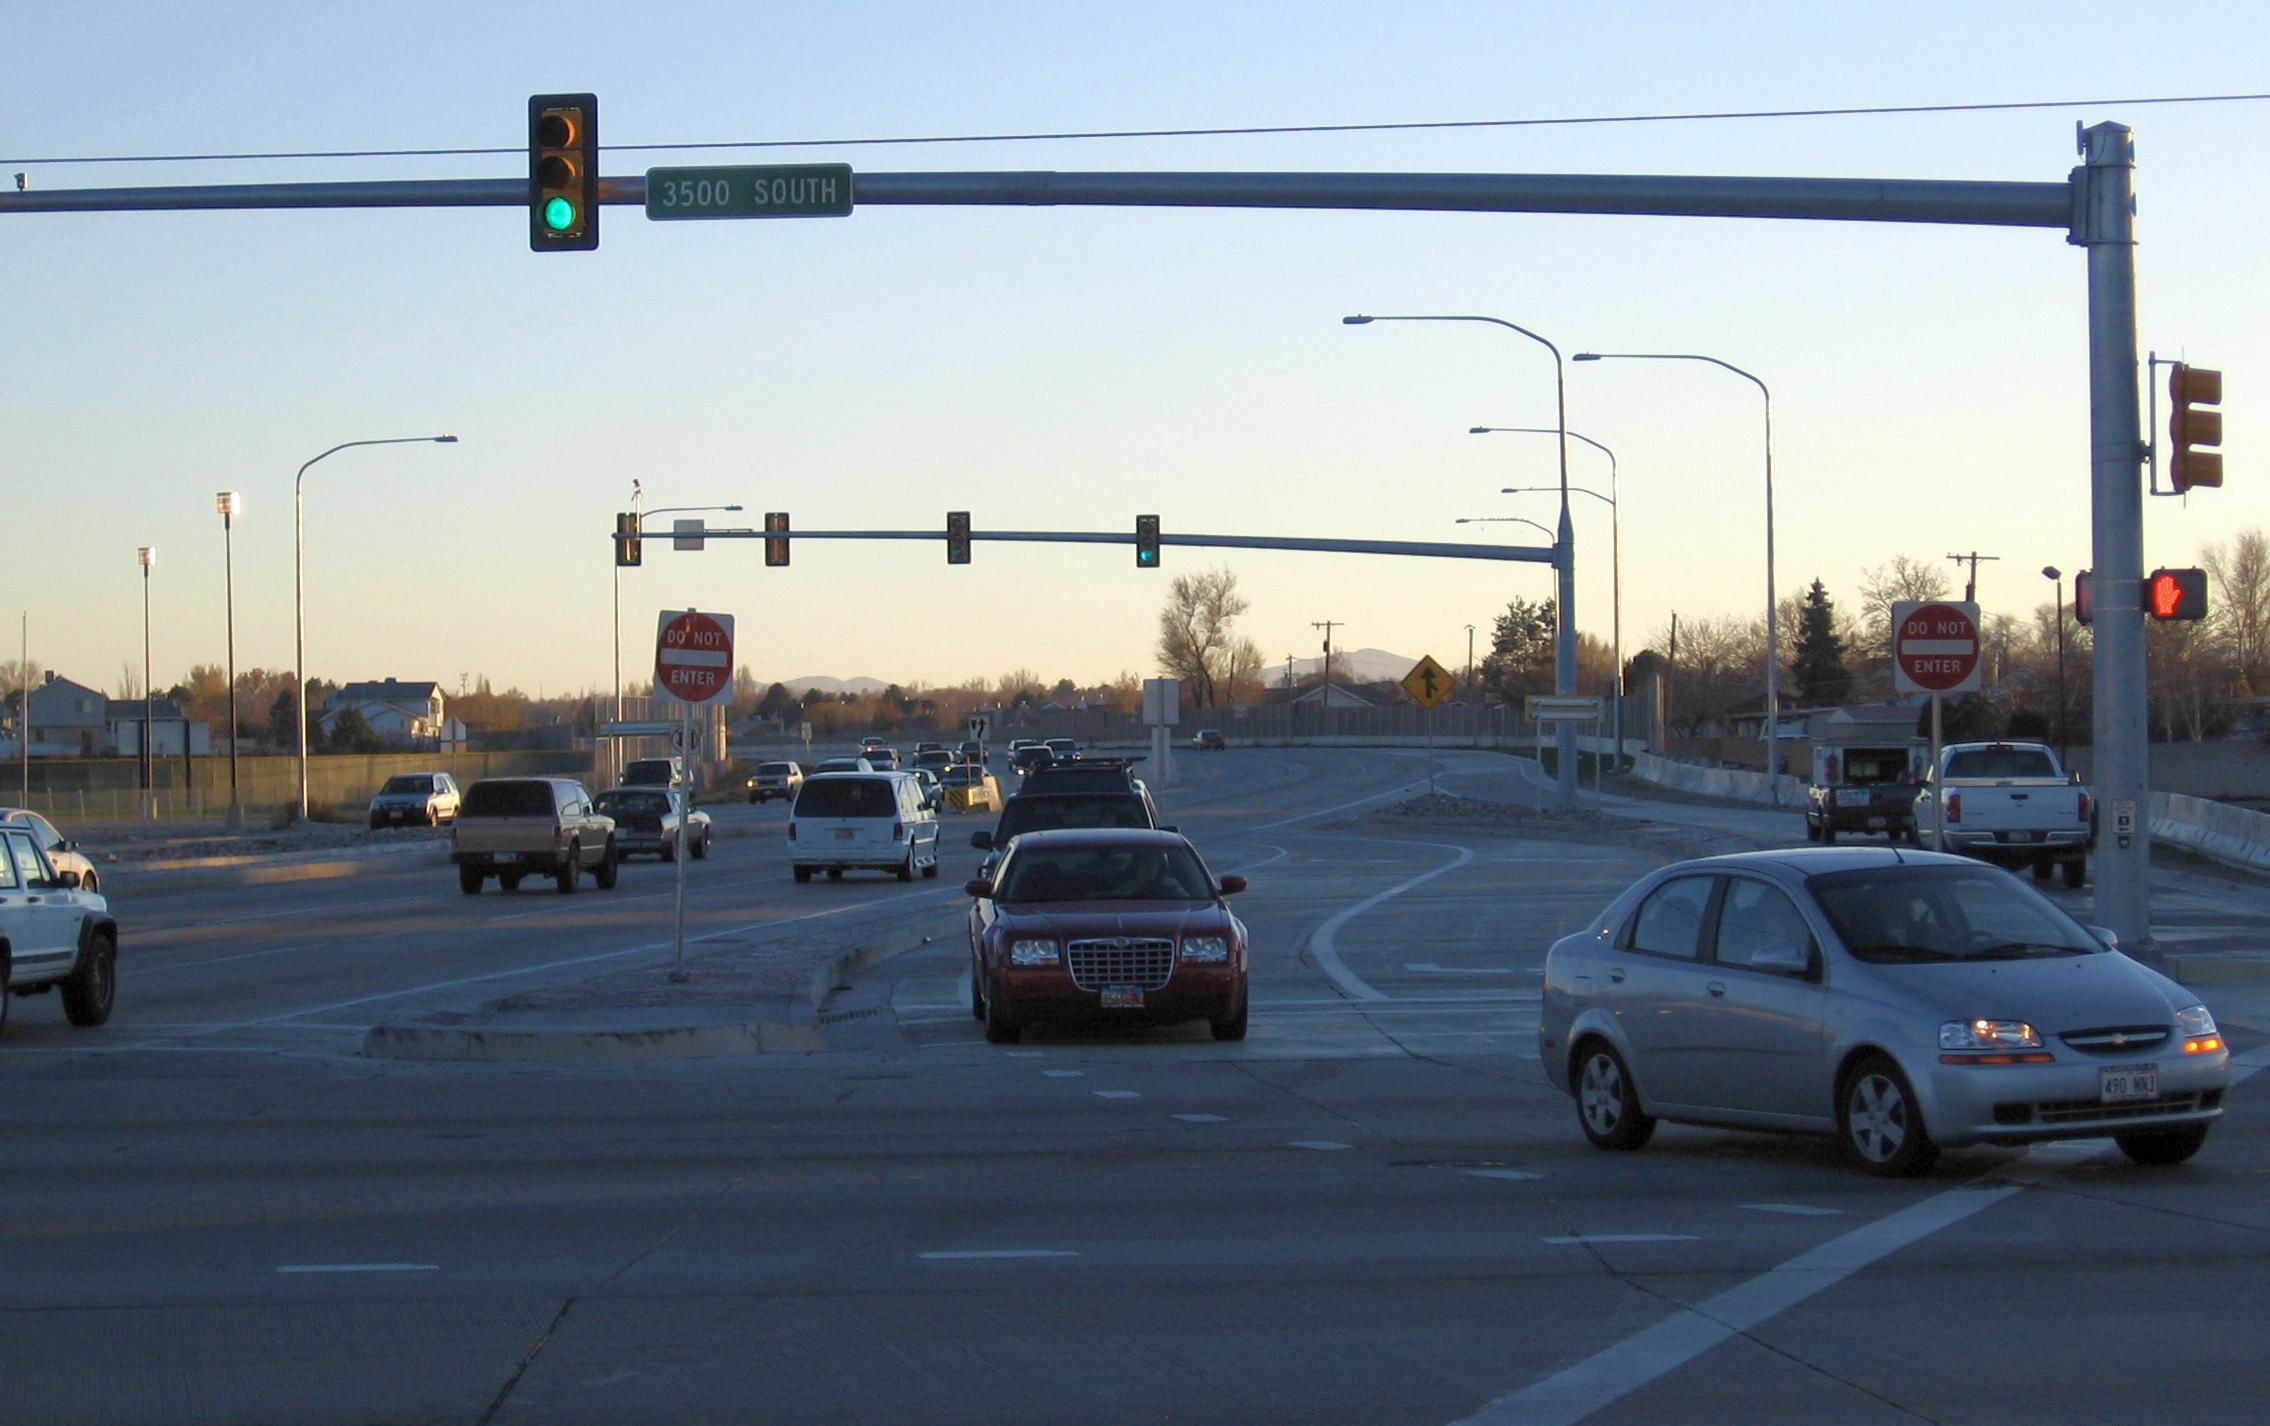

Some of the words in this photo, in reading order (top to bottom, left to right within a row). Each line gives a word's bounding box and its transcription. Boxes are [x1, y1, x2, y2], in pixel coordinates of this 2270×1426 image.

[663, 180, 729, 207] 3500
[754, 177, 837, 204] SOUTH
[1908, 621, 1928, 635] DO
[1938, 621, 1966, 635] NOT
[667, 630, 686, 643] DO
[694, 632, 721, 645] NOT
[1914, 660, 1961, 673] ENTER
[671, 669, 715, 685] ENTER
